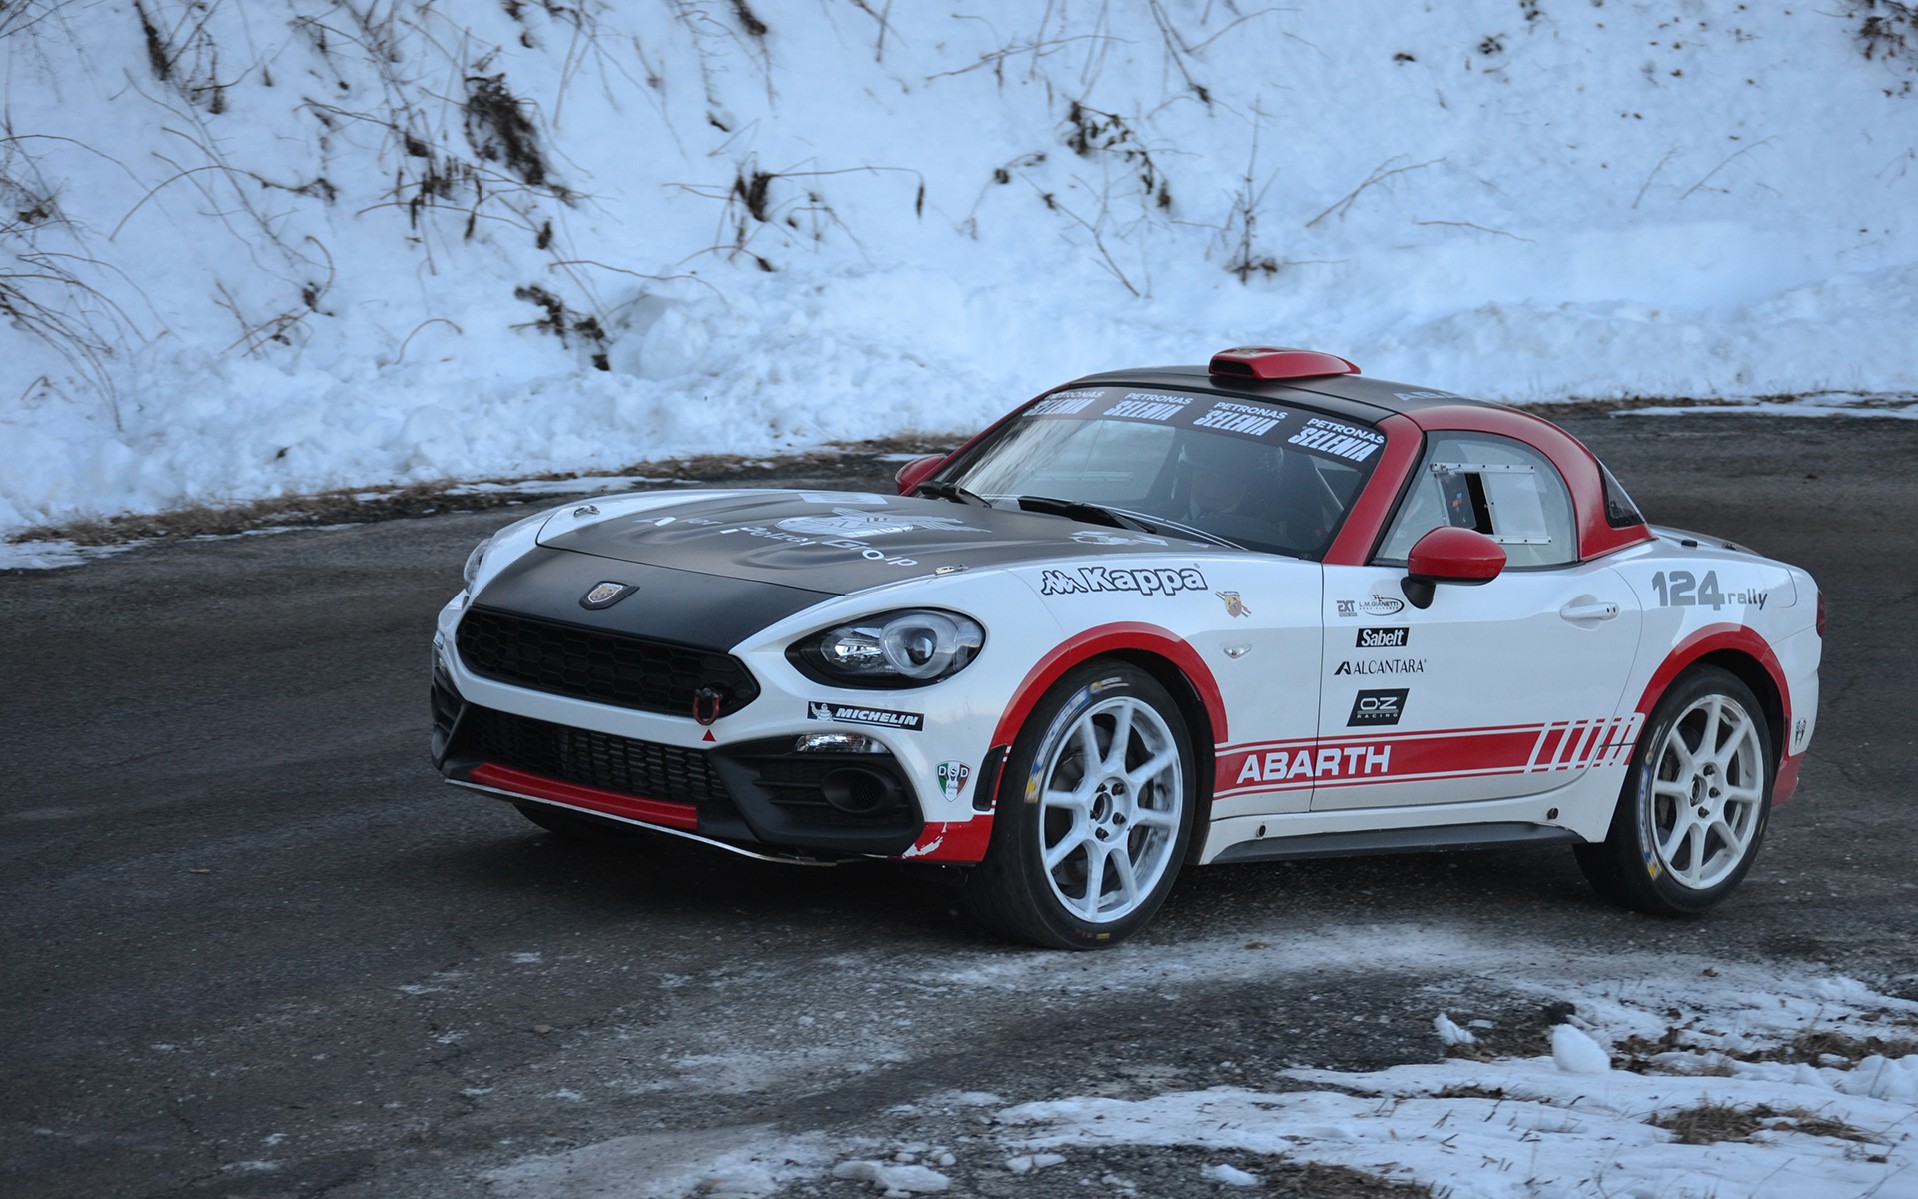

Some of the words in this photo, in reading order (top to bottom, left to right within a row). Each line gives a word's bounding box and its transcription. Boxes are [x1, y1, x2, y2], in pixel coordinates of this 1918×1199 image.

[1125, 392, 1193, 405] PETRONAS
[1103, 400, 1185, 421] SELENIA
[1214, 402, 1288, 419] PETRONAS
[1193, 410, 1280, 436] SELENIA
[1307, 418, 1385, 444] PETRONAS
[1288, 428, 1379, 462] SELENIA
[1078, 566, 1208, 596] Kappa
[1652, 570, 1726, 611] 124
[1727, 588, 1768, 610] rally
[1361, 629, 1404, 646] Sabelt
[1353, 659, 1424, 674] ALCANTARA
[836, 707, 919, 727] MICHELIN
[1236, 745, 1392, 785] ABARTH
